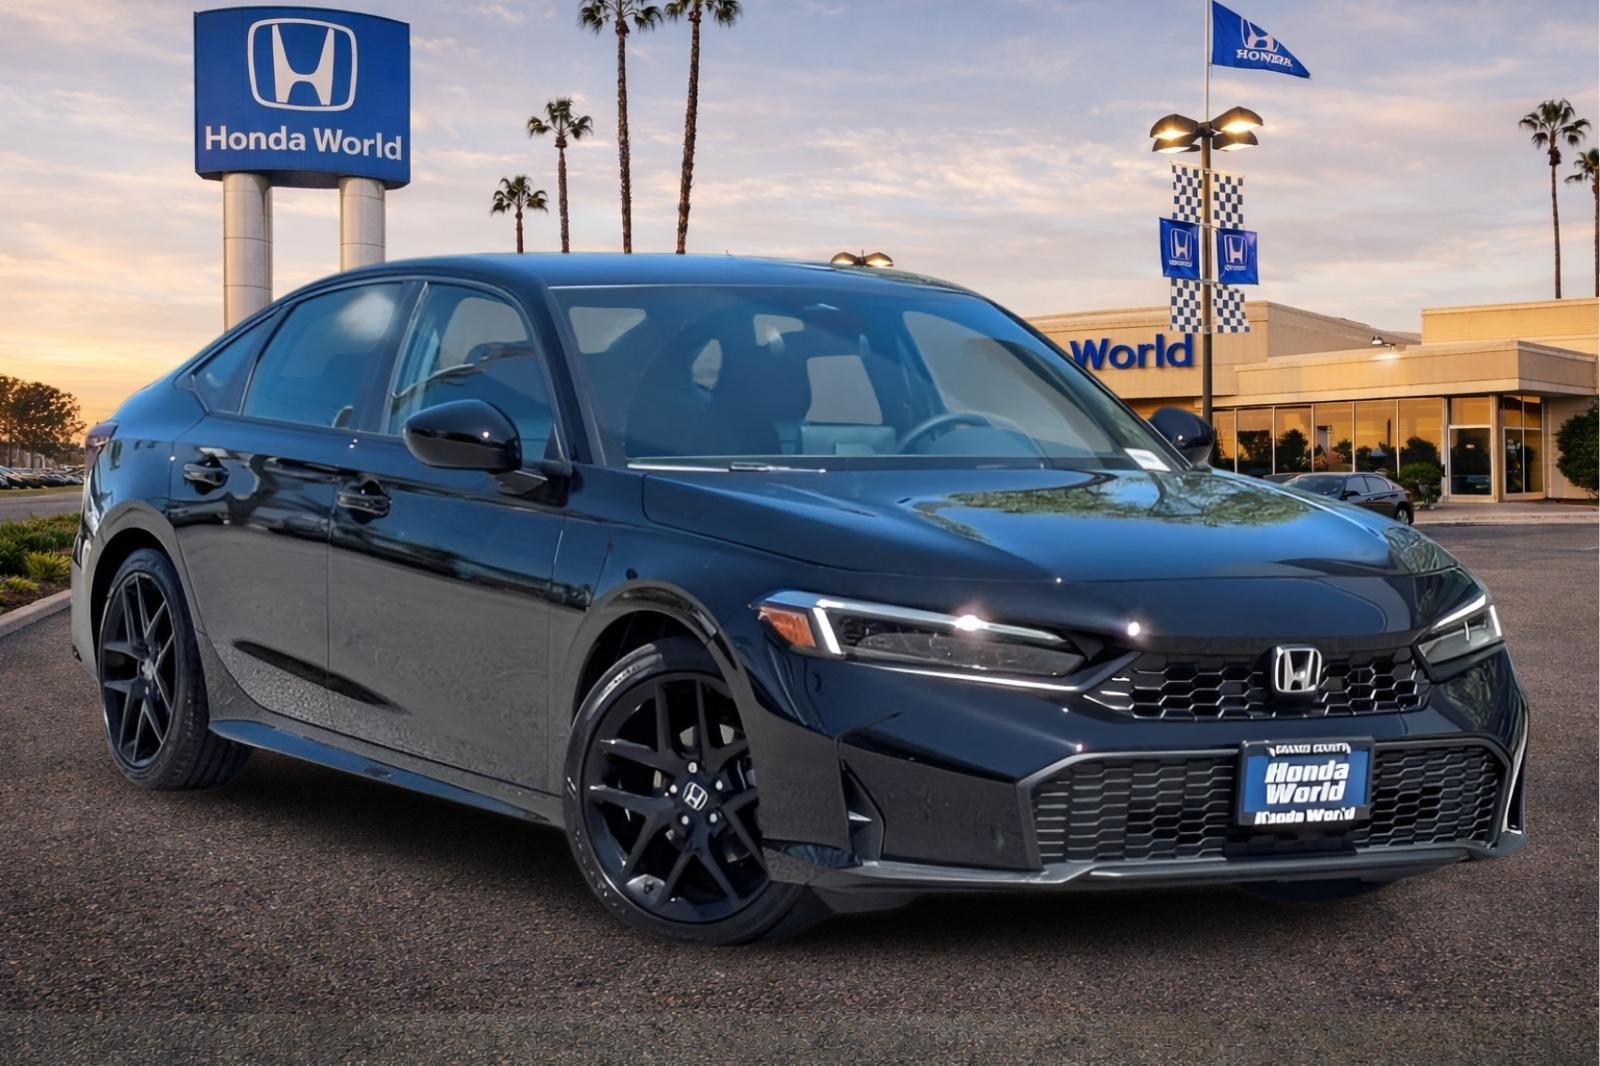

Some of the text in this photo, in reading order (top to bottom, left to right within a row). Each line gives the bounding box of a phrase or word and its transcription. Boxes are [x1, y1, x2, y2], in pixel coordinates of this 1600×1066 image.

[205, 125, 402, 161] Honda World
[1069, 333, 1194, 371] World
[1264, 760, 1350, 784] Honda
[1266, 780, 1347, 805] World
